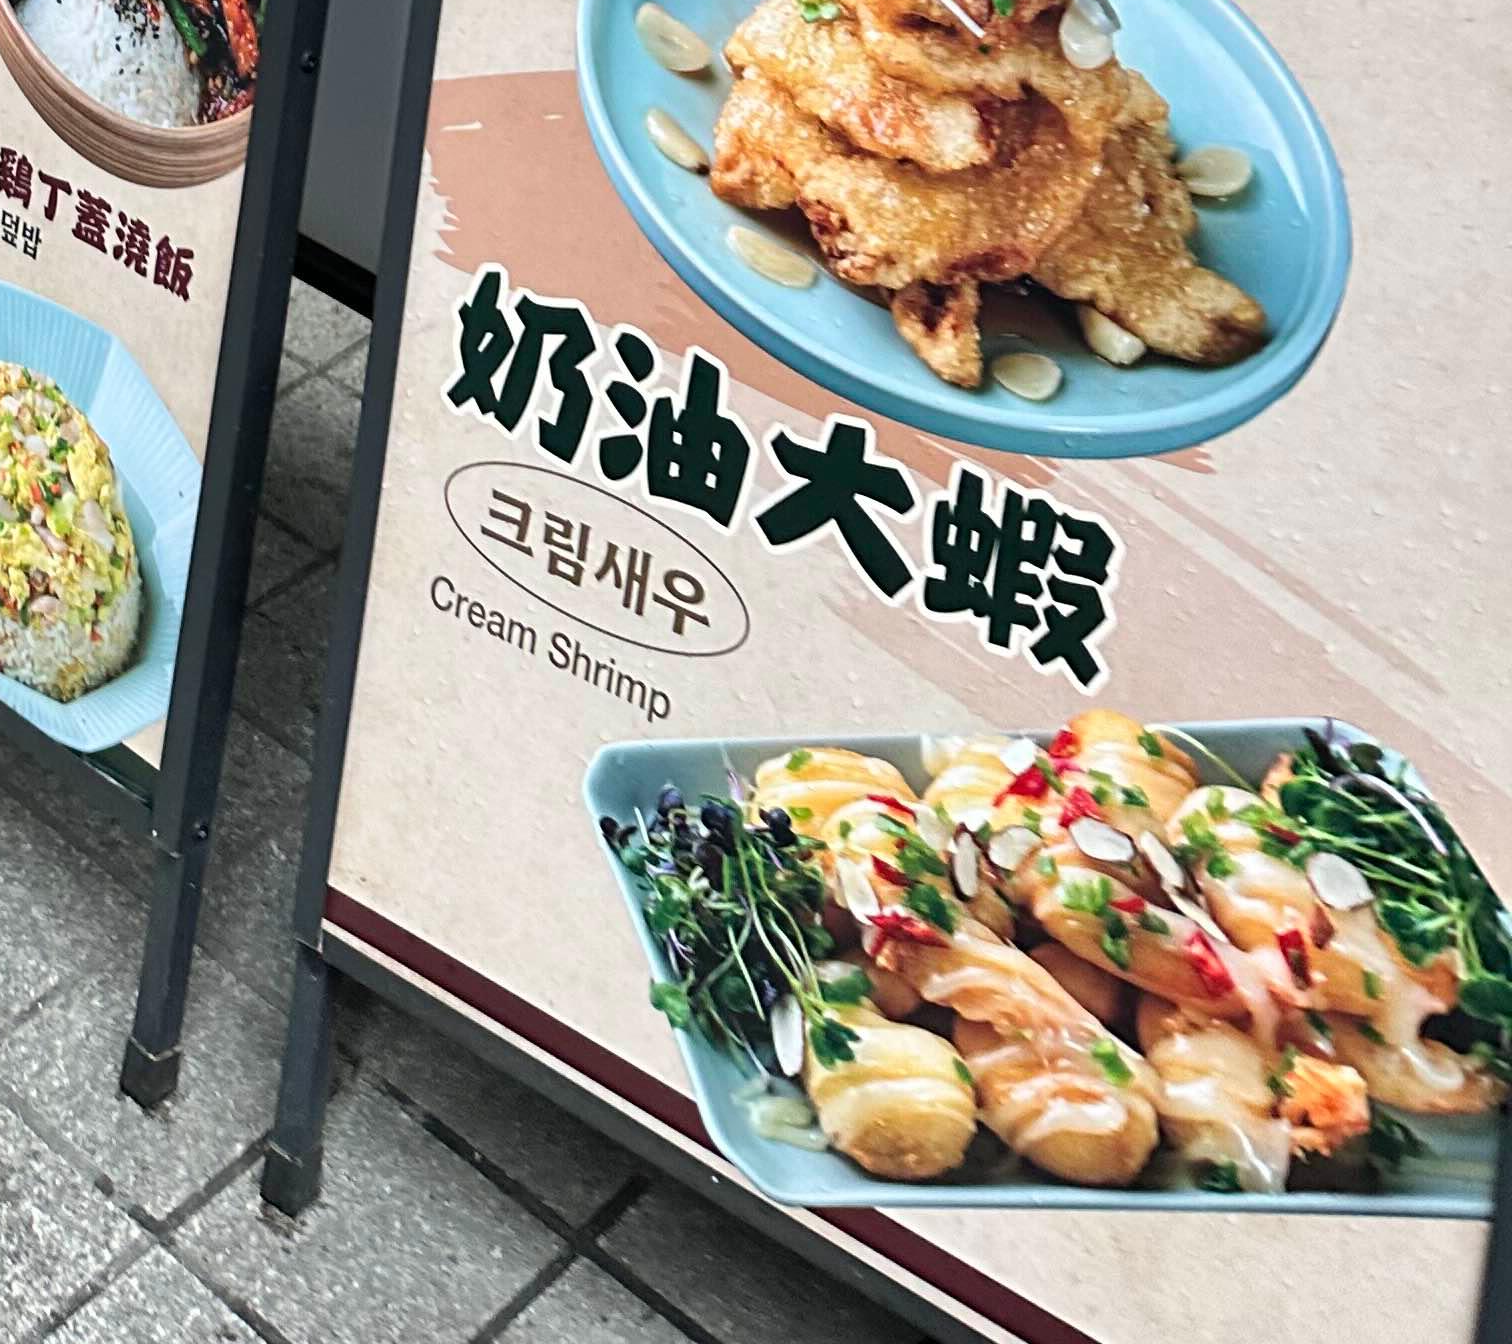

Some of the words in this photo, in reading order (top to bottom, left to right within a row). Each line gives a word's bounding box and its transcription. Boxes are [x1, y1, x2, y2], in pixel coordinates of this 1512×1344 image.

[445, 271, 1116, 686] 奶油大蝦
[480, 488, 711, 635] 크림새우
[430, 575, 537, 655] Cream
[548, 631, 671, 723] Shrimp
